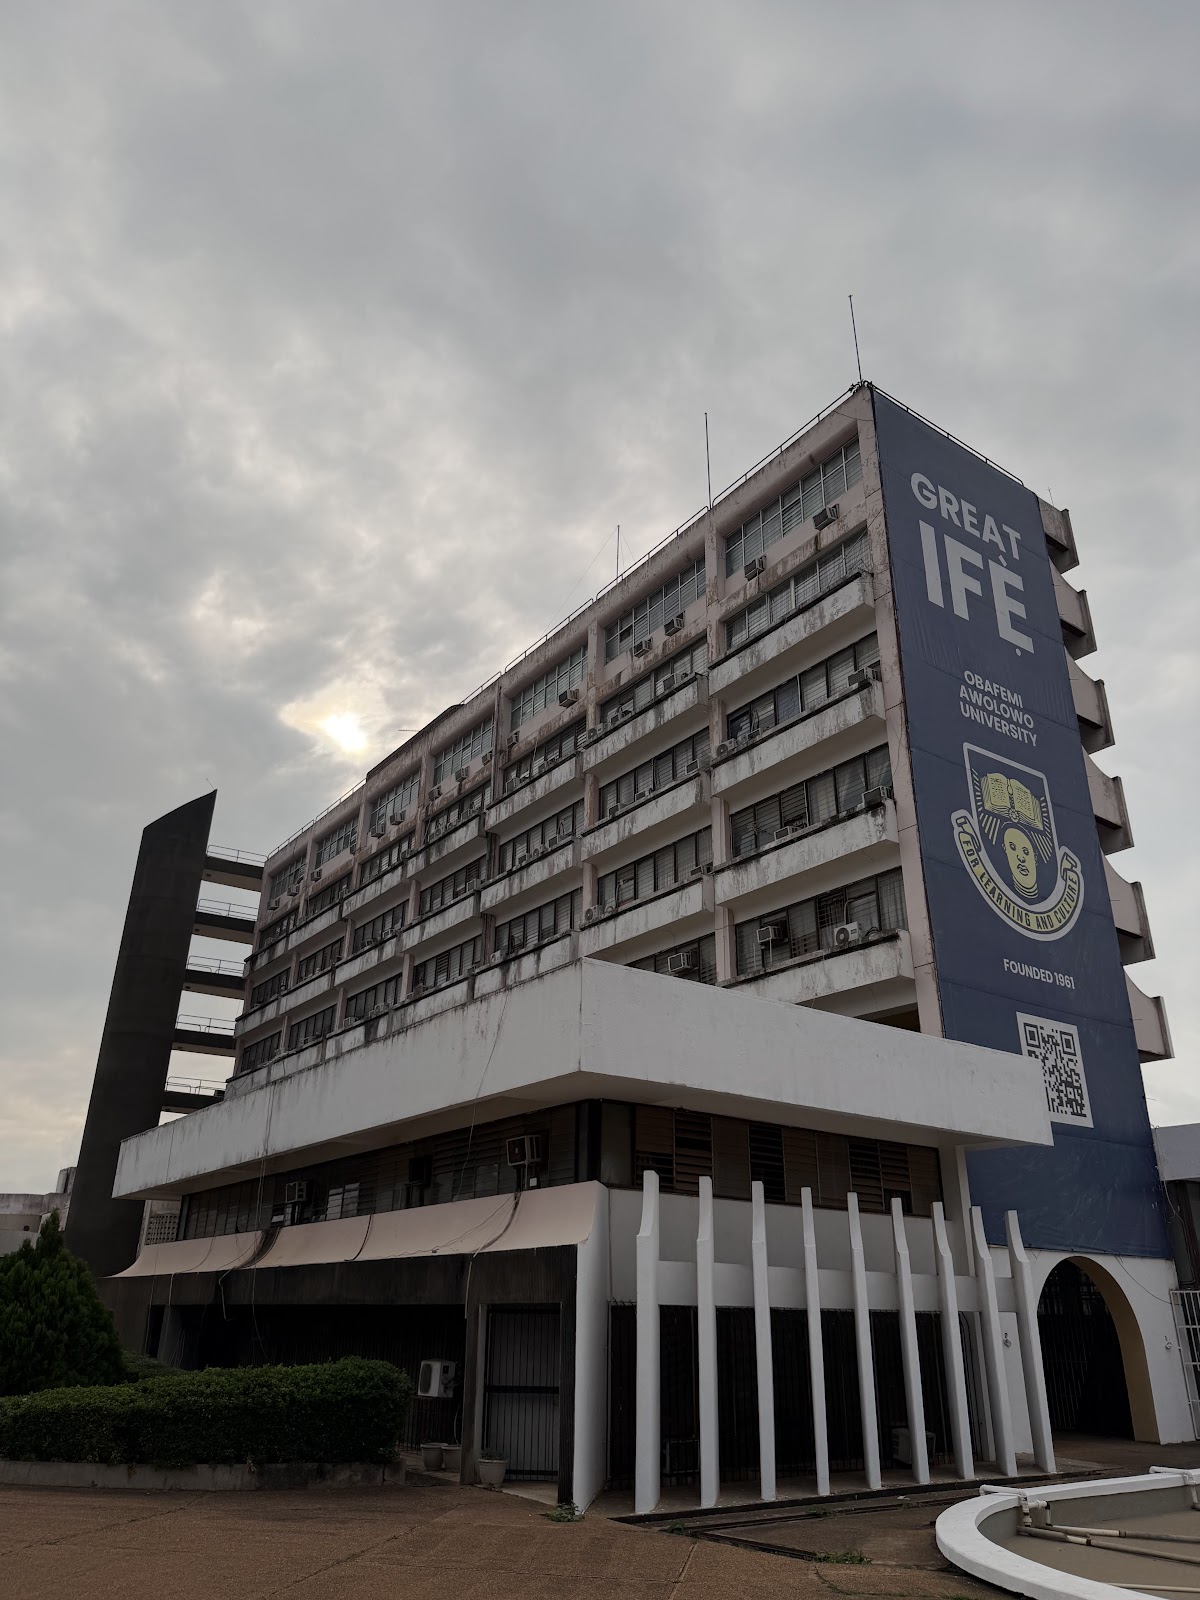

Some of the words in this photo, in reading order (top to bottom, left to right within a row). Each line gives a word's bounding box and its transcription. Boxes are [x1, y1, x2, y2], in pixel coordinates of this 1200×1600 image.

[910, 472, 1021, 561] GREAT
[960, 684, 1034, 729] AWOLOWO
[964, 670, 1023, 709] OBAFEMI
[959, 701, 1037, 747] UNIVERSITY
[962, 840, 980, 868] FOR
[979, 872, 1031, 927] LEARNING
[1035, 914, 1055, 930] AND
[1053, 875, 1078, 924] CULTURE
[1003, 958, 1053, 984] FOUNDED
[1054, 972, 1076, 990] 1961
